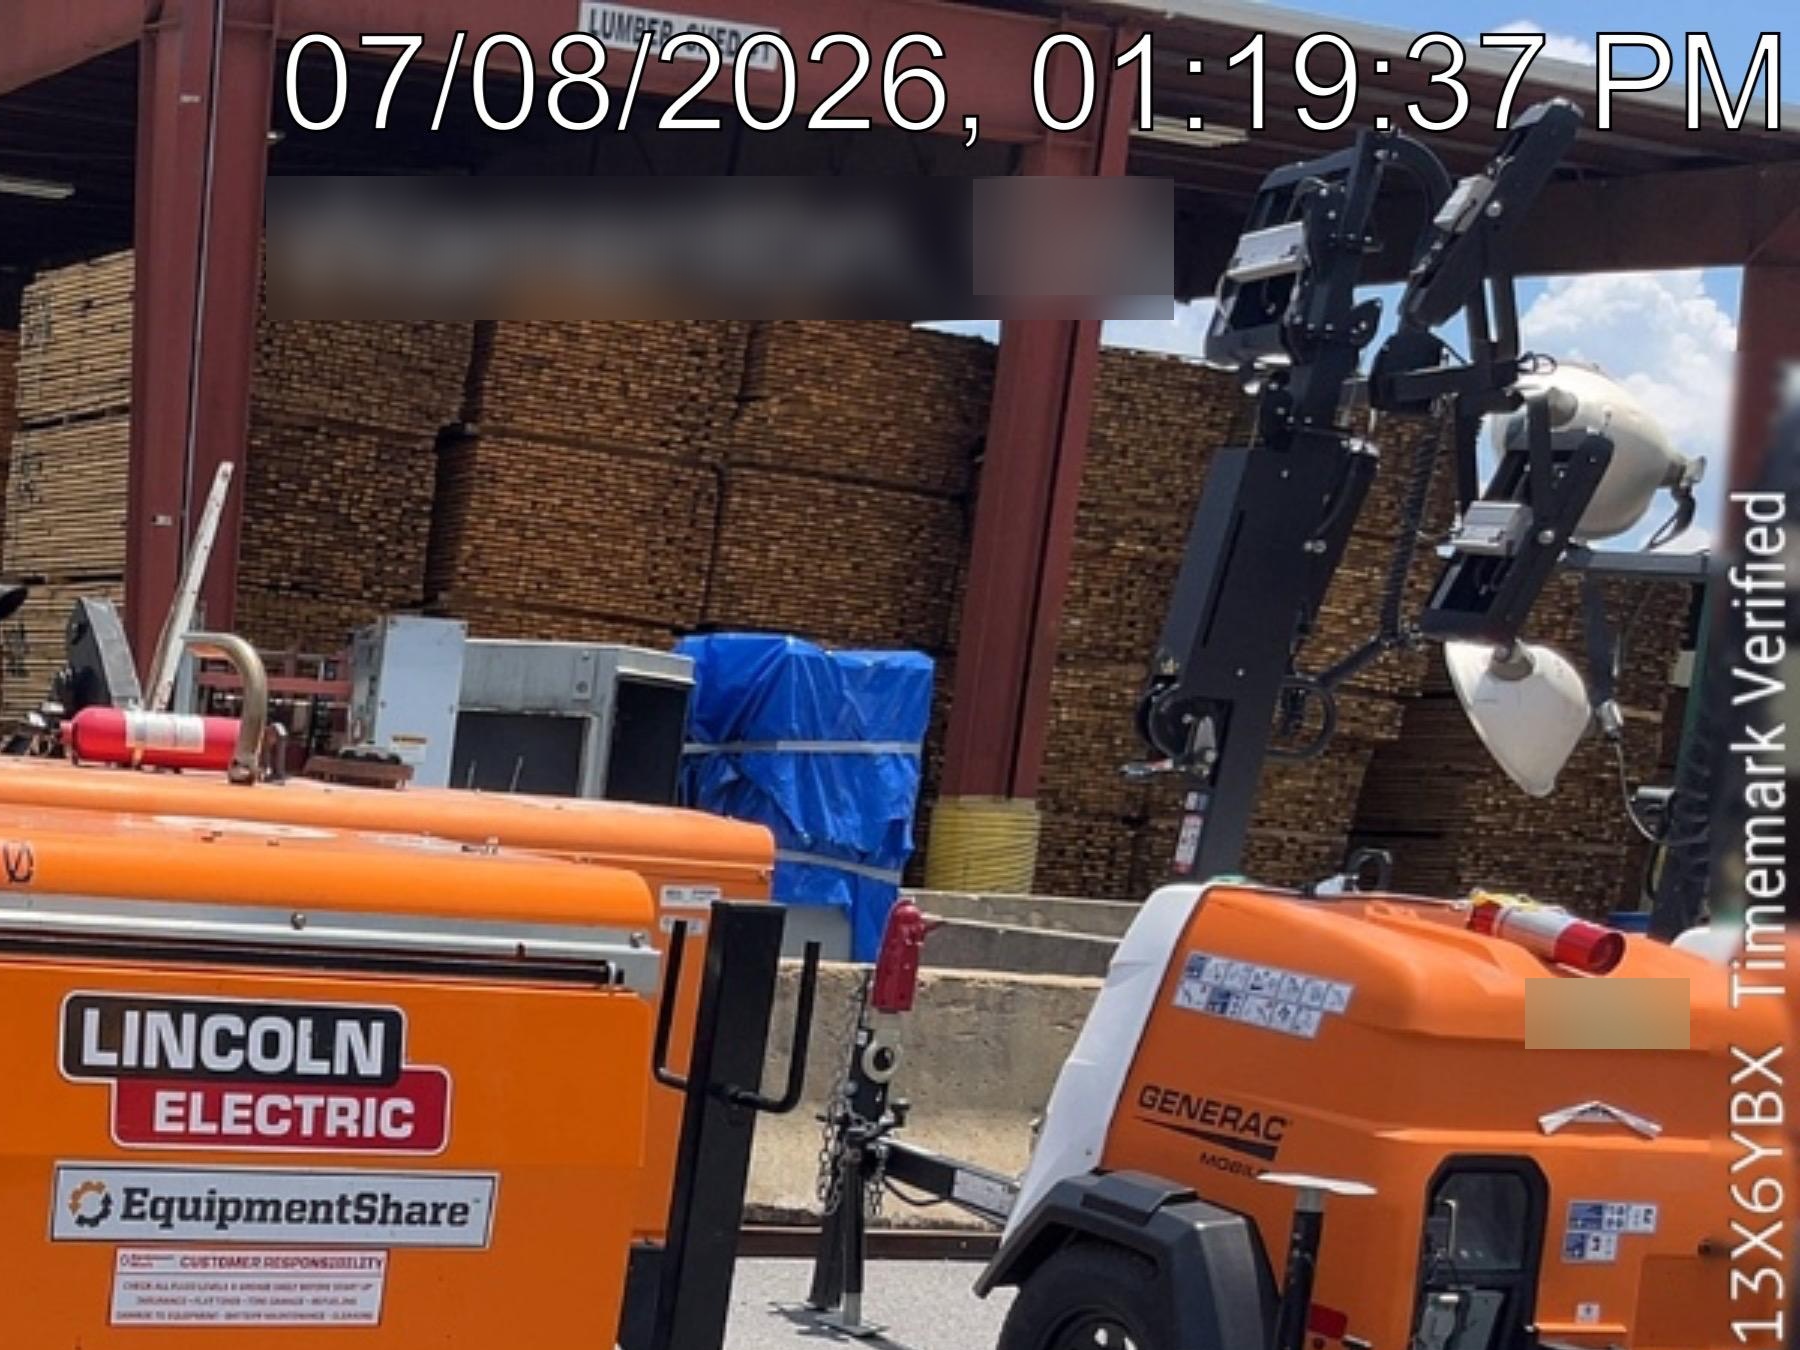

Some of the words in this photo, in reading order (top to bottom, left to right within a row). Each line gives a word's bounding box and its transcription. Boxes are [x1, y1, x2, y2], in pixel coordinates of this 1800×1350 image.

[589, 8, 674, 49] LUMBER
[82, 1007, 385, 1077] LINCOLN
[152, 1091, 415, 1138] ELECTRIC
[1139, 1085, 1288, 1142] GENERAC
[120, 1186, 470, 1231] EquipmentShare
[179, 1255, 261, 1270] CUSTOMER
[264, 1255, 382, 1270] RESPONSIBILITY
